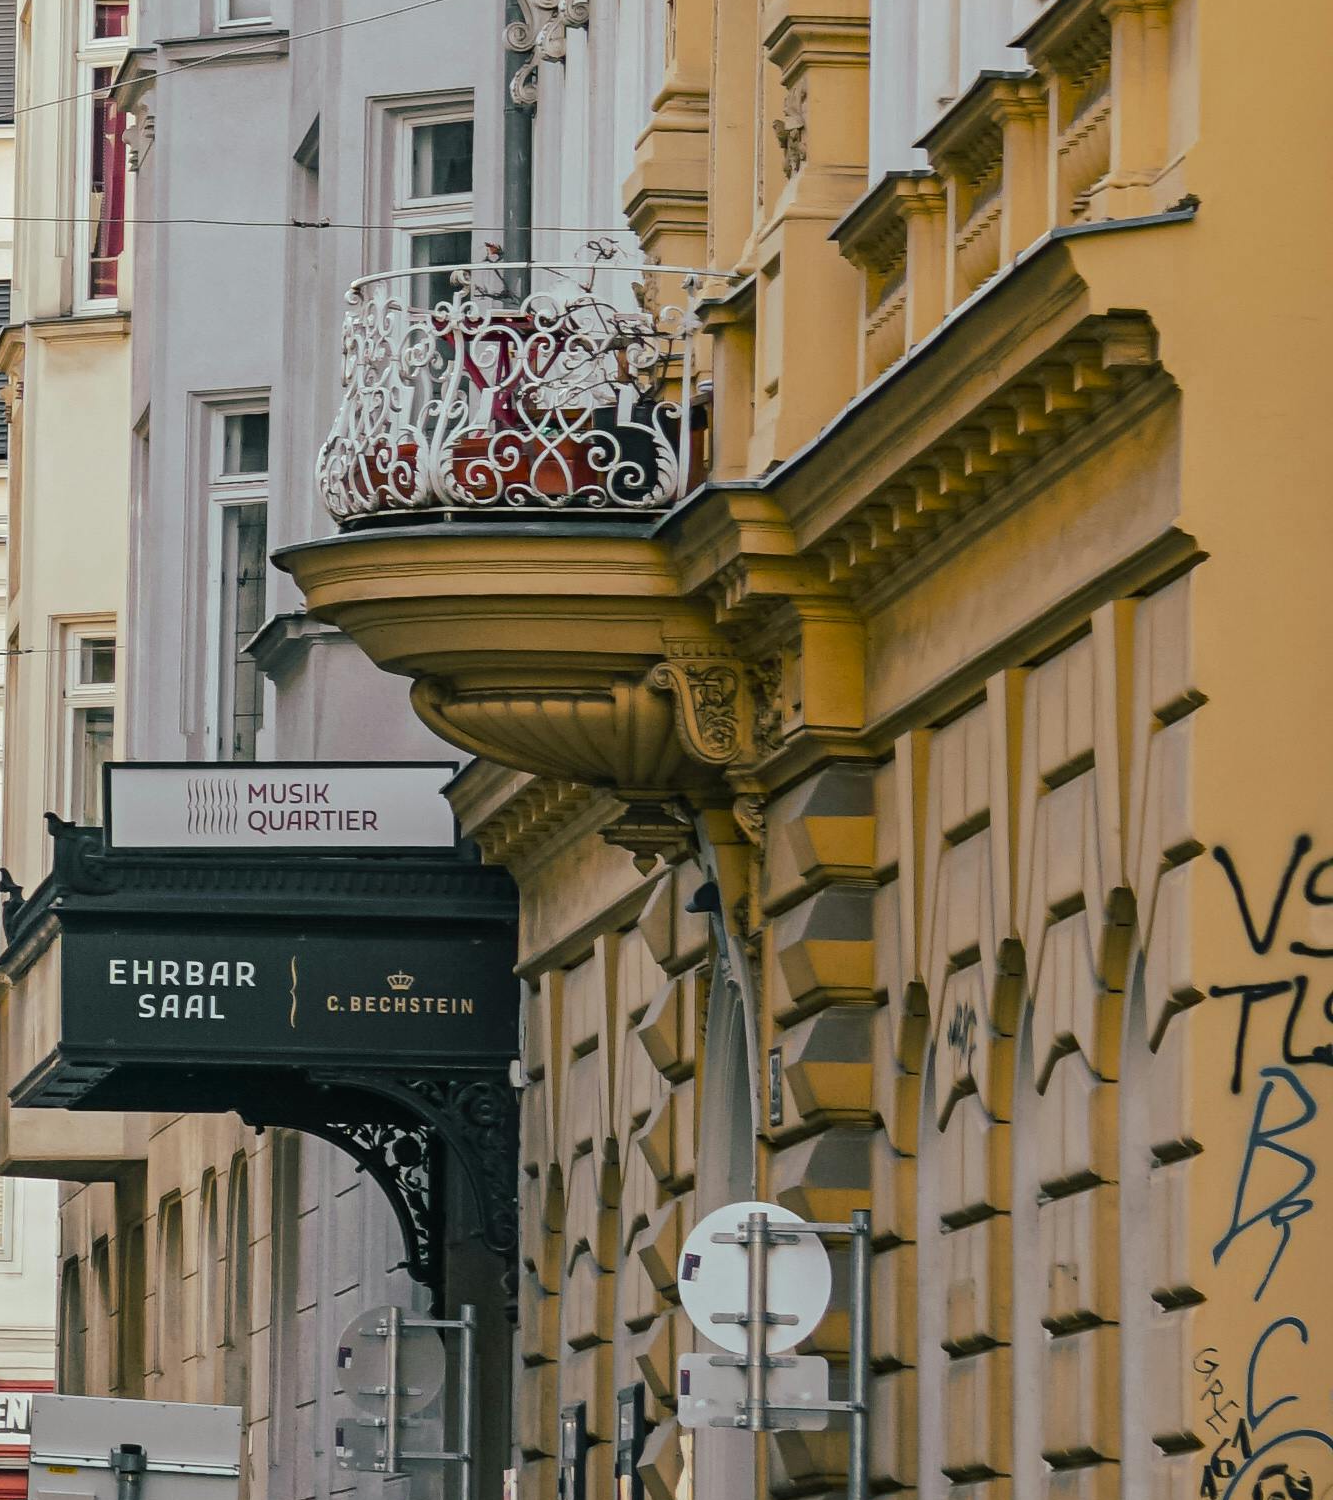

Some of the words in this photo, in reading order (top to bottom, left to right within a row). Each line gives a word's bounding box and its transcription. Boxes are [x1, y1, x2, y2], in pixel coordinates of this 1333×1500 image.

[247, 783, 330, 804] MUSIK
[247, 810, 379, 835] QUARTIER
[108, 958, 257, 988] EHRBAR
[137, 993, 225, 1020] SAAL
[326, 995, 345, 1013] C.
[349, 996, 474, 1015] BECHSTEIN
